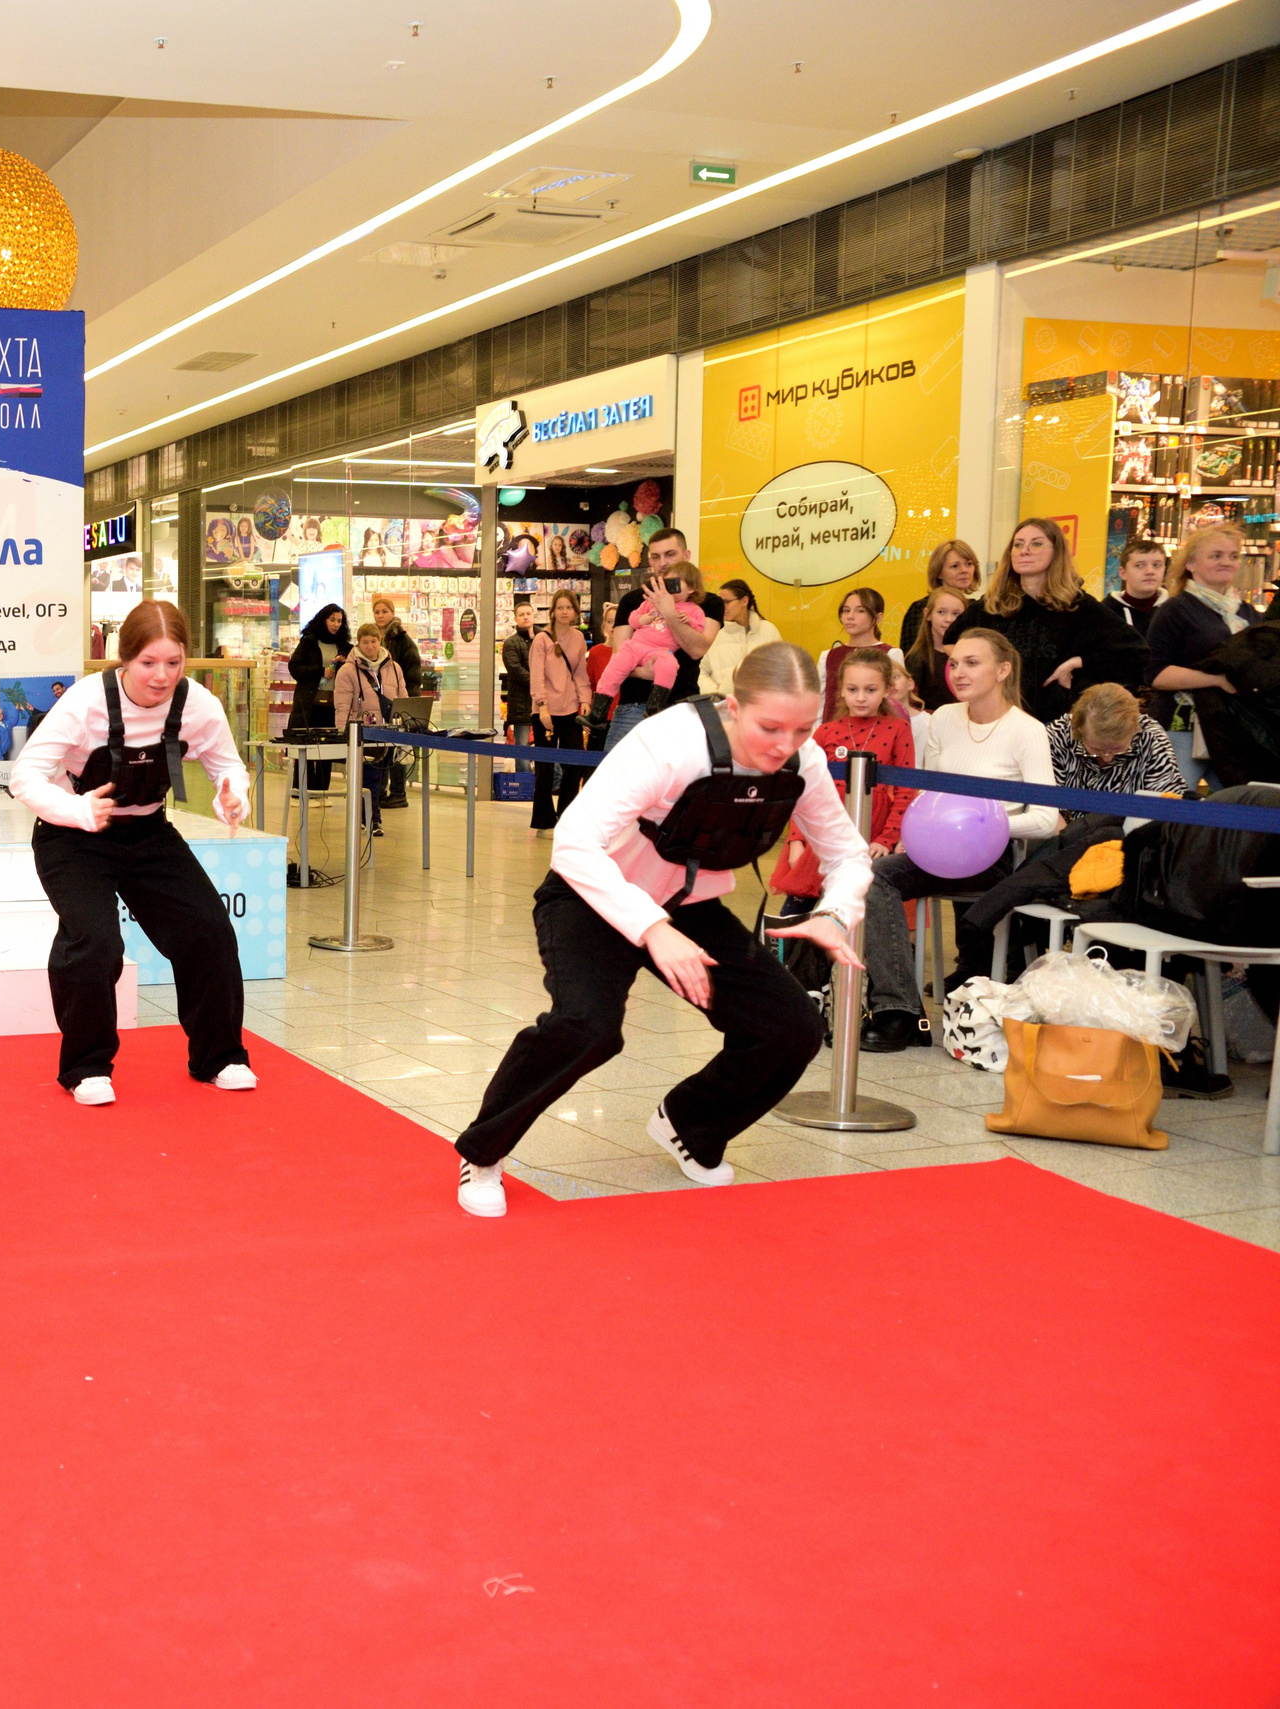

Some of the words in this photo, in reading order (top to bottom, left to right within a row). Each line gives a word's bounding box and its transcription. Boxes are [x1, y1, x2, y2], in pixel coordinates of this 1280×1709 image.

[532, 409, 599, 443] ВЕСЁЛАЯ
[600, 394, 653, 428] ЗАТЕЯ
[776, 490, 854, 518] Собирай,
[755, 526, 805, 553] играй,
[810, 518, 877, 545] мечтай!
[35, 603, 68, 618] ОГЭ
